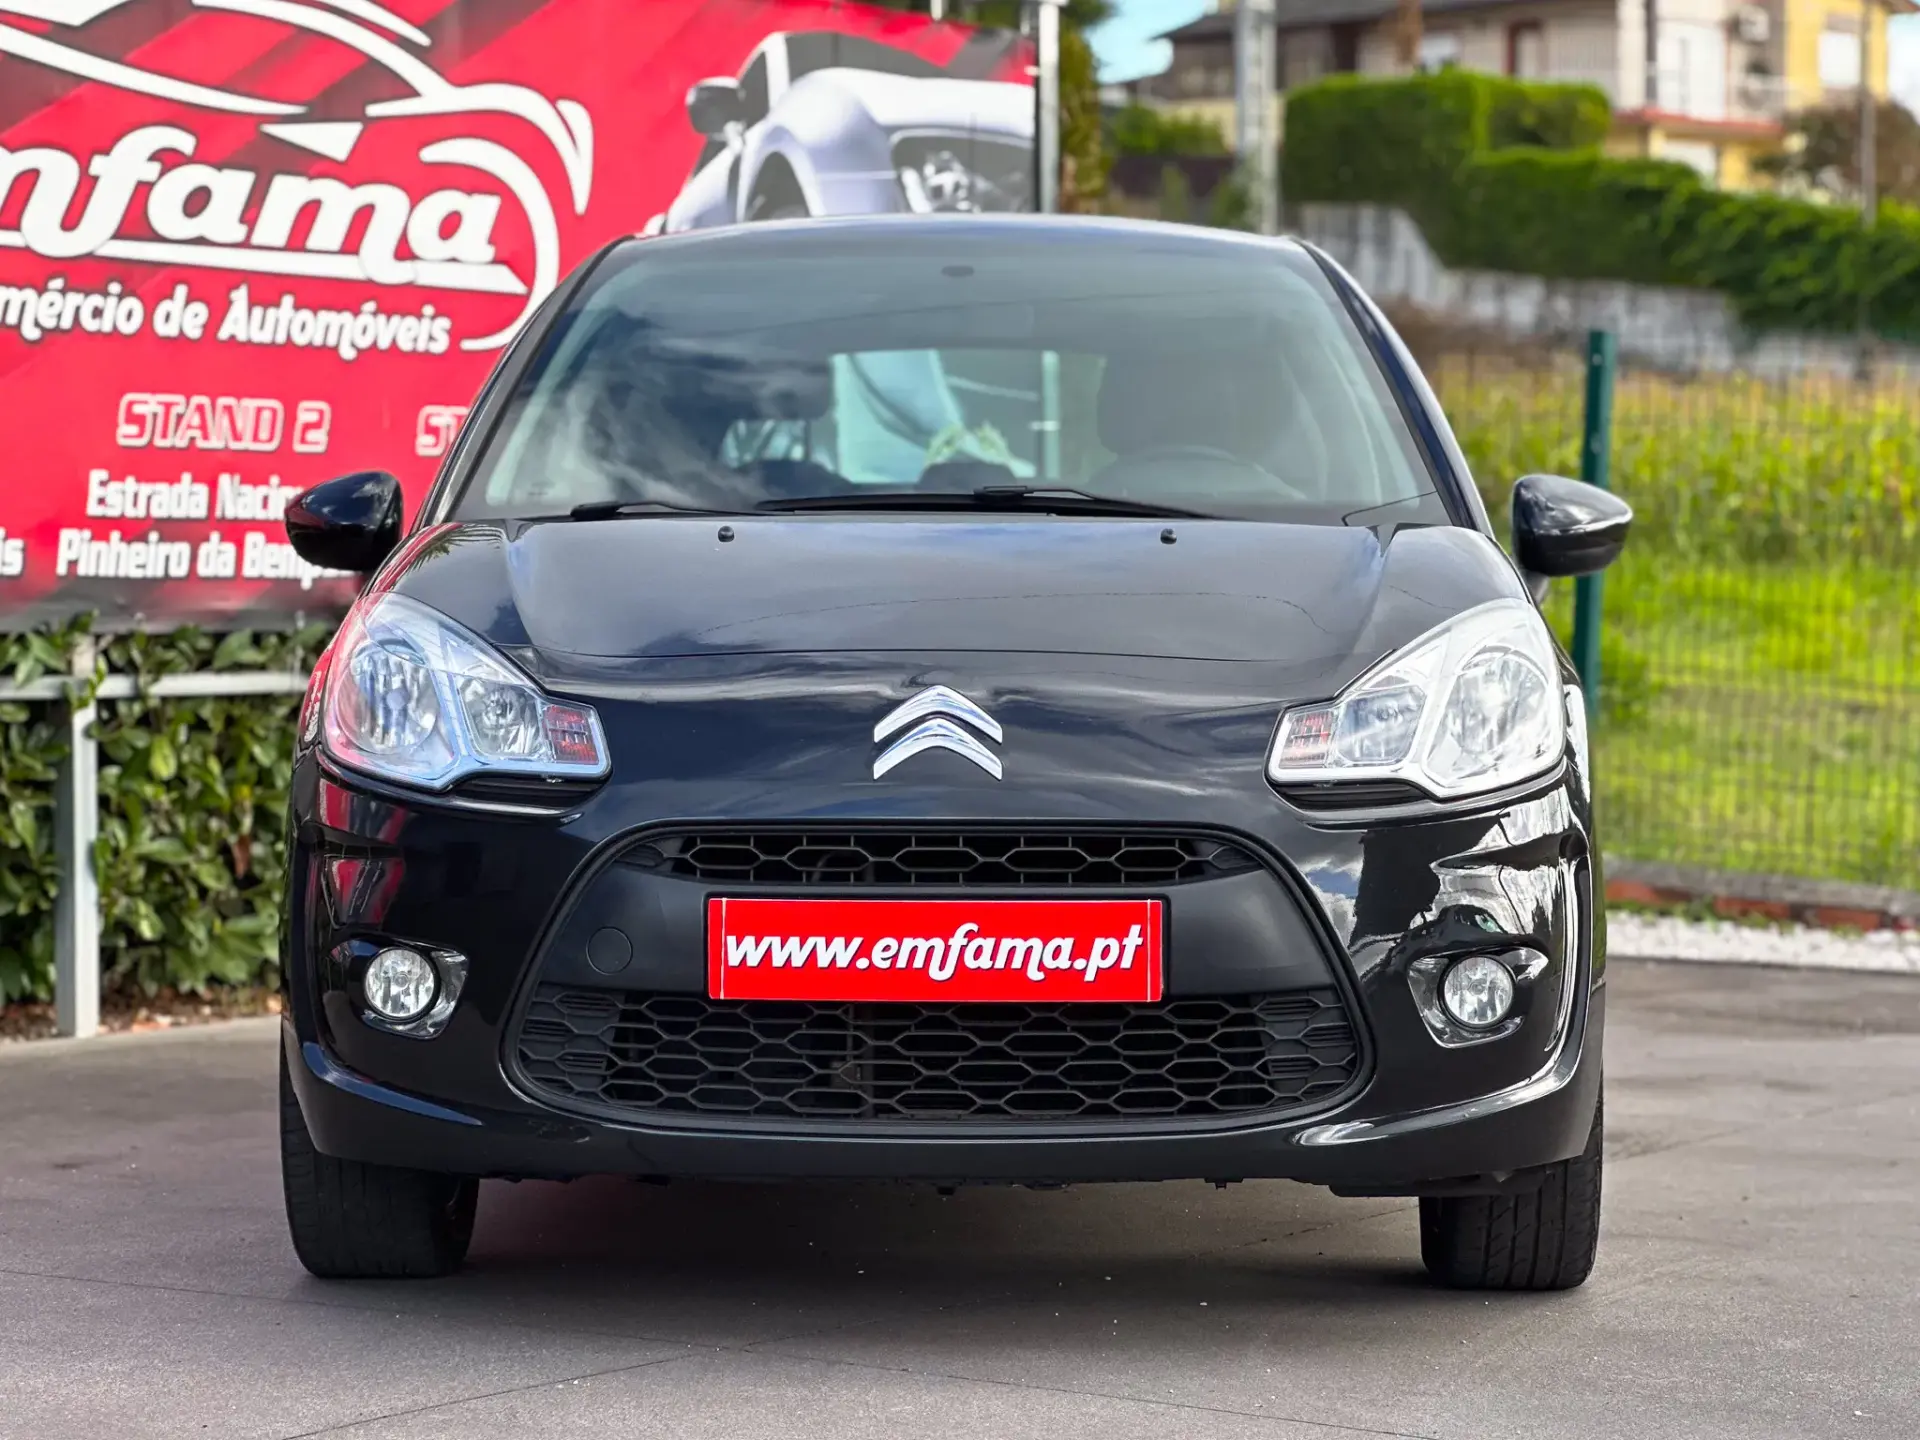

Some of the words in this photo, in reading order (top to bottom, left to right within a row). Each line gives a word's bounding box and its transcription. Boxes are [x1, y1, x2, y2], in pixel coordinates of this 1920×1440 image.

[153, 283, 209, 339] de
[116, 392, 285, 452] STAND
[292, 400, 331, 453] 2
[86, 468, 209, 520] Estrada
[56, 527, 191, 578] Pinheiro
[196, 530, 237, 578] da
[726, 922, 1144, 982] www.emfama.pt
